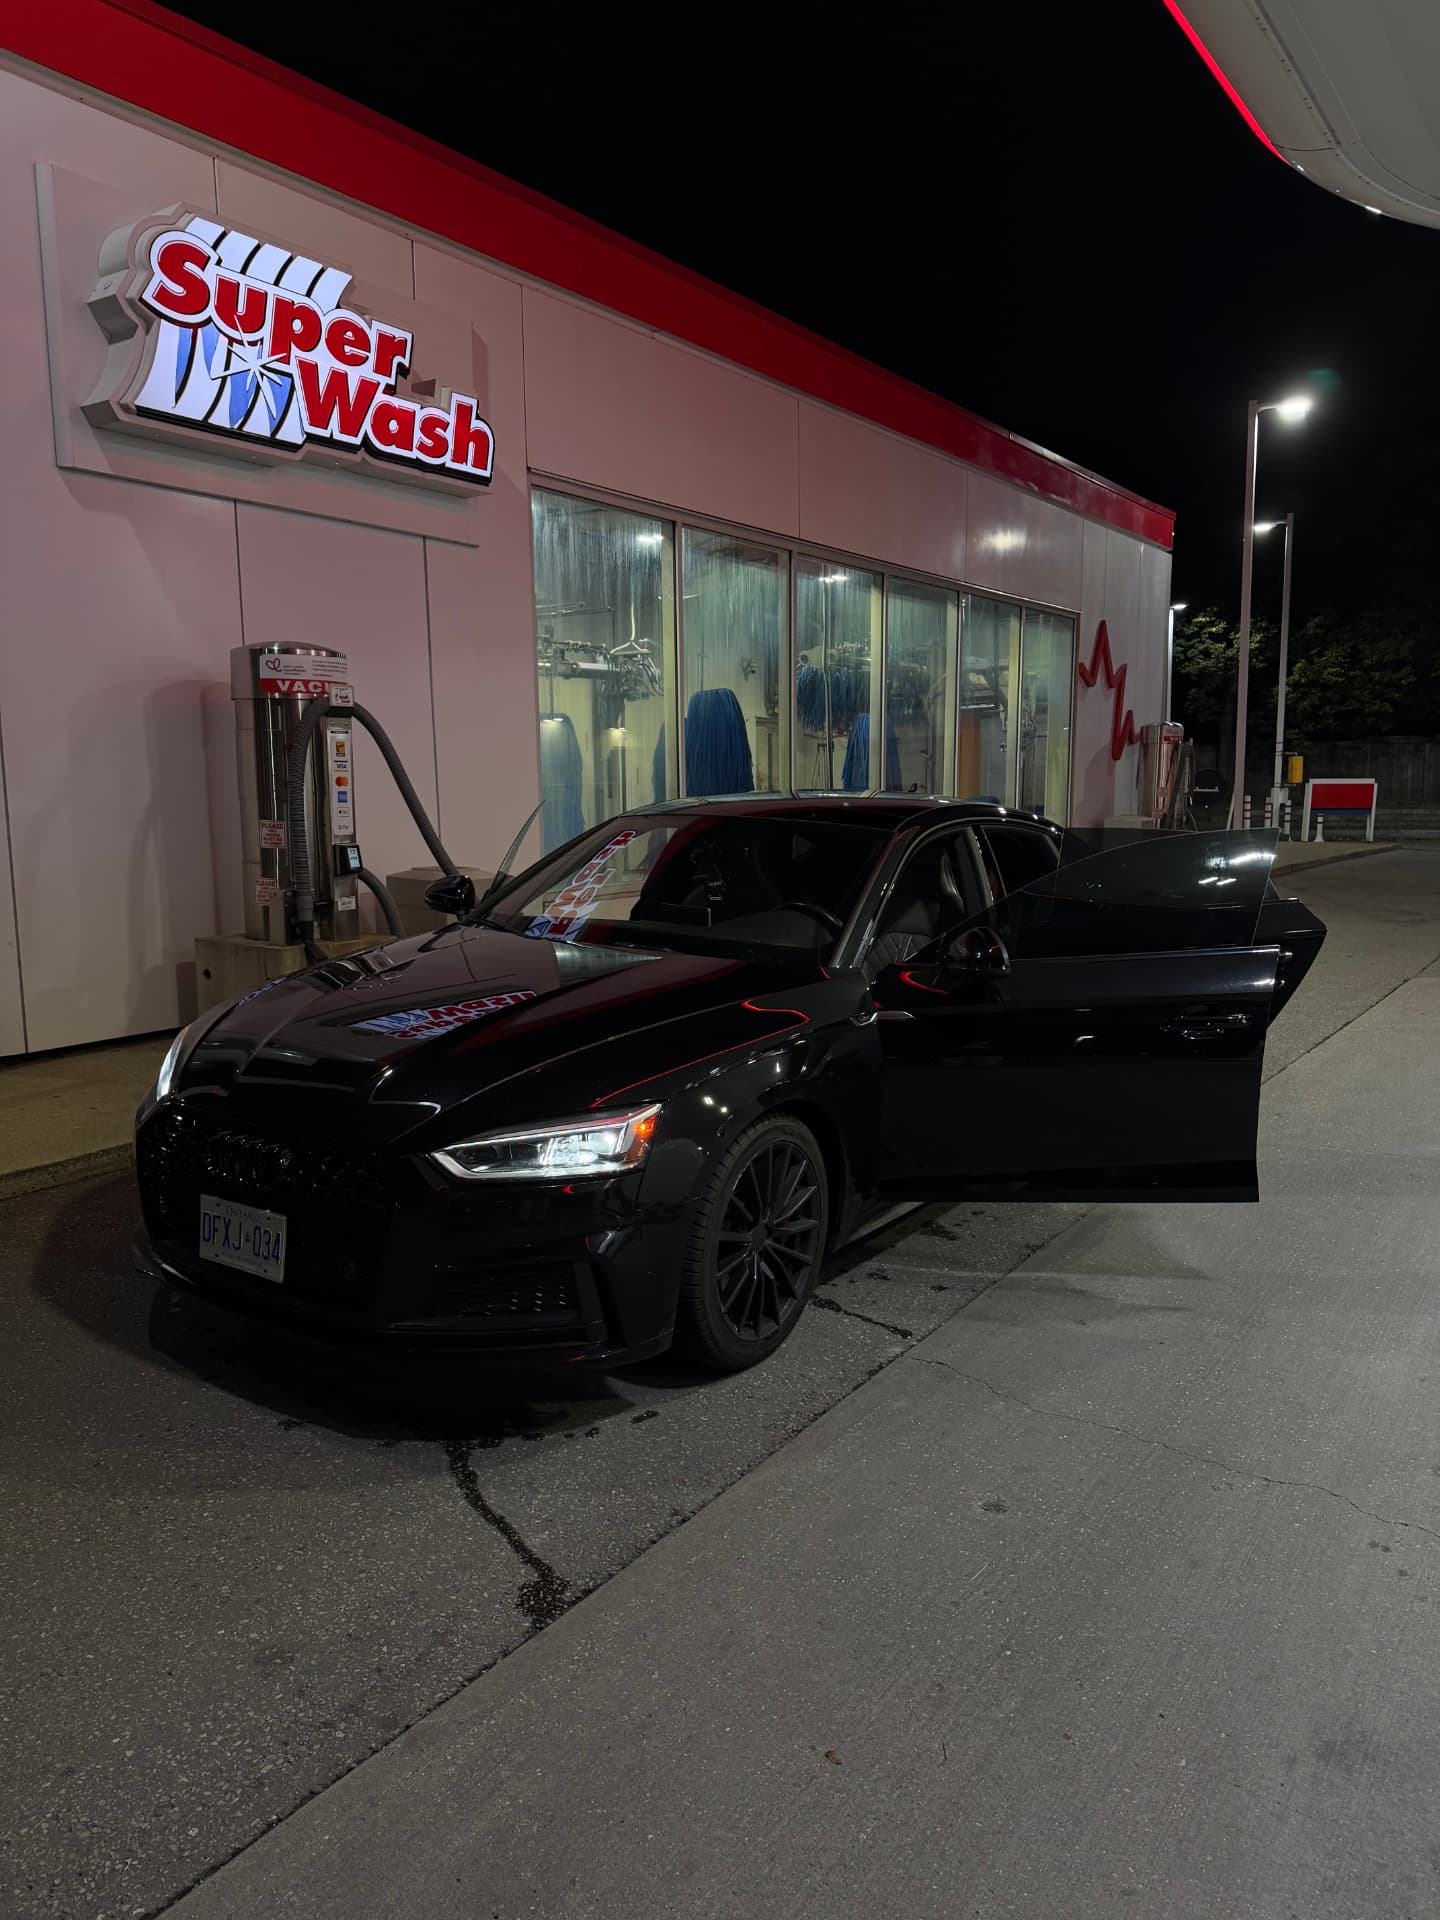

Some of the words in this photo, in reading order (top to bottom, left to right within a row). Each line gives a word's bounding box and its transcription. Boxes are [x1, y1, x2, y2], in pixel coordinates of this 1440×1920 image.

[152, 240, 407, 377] Super
[296, 356, 491, 472] Wash
[261, 822, 284, 830] PLEASE
[202, 1211, 242, 1251] DFXJ
[253, 1225, 281, 1264] 034
